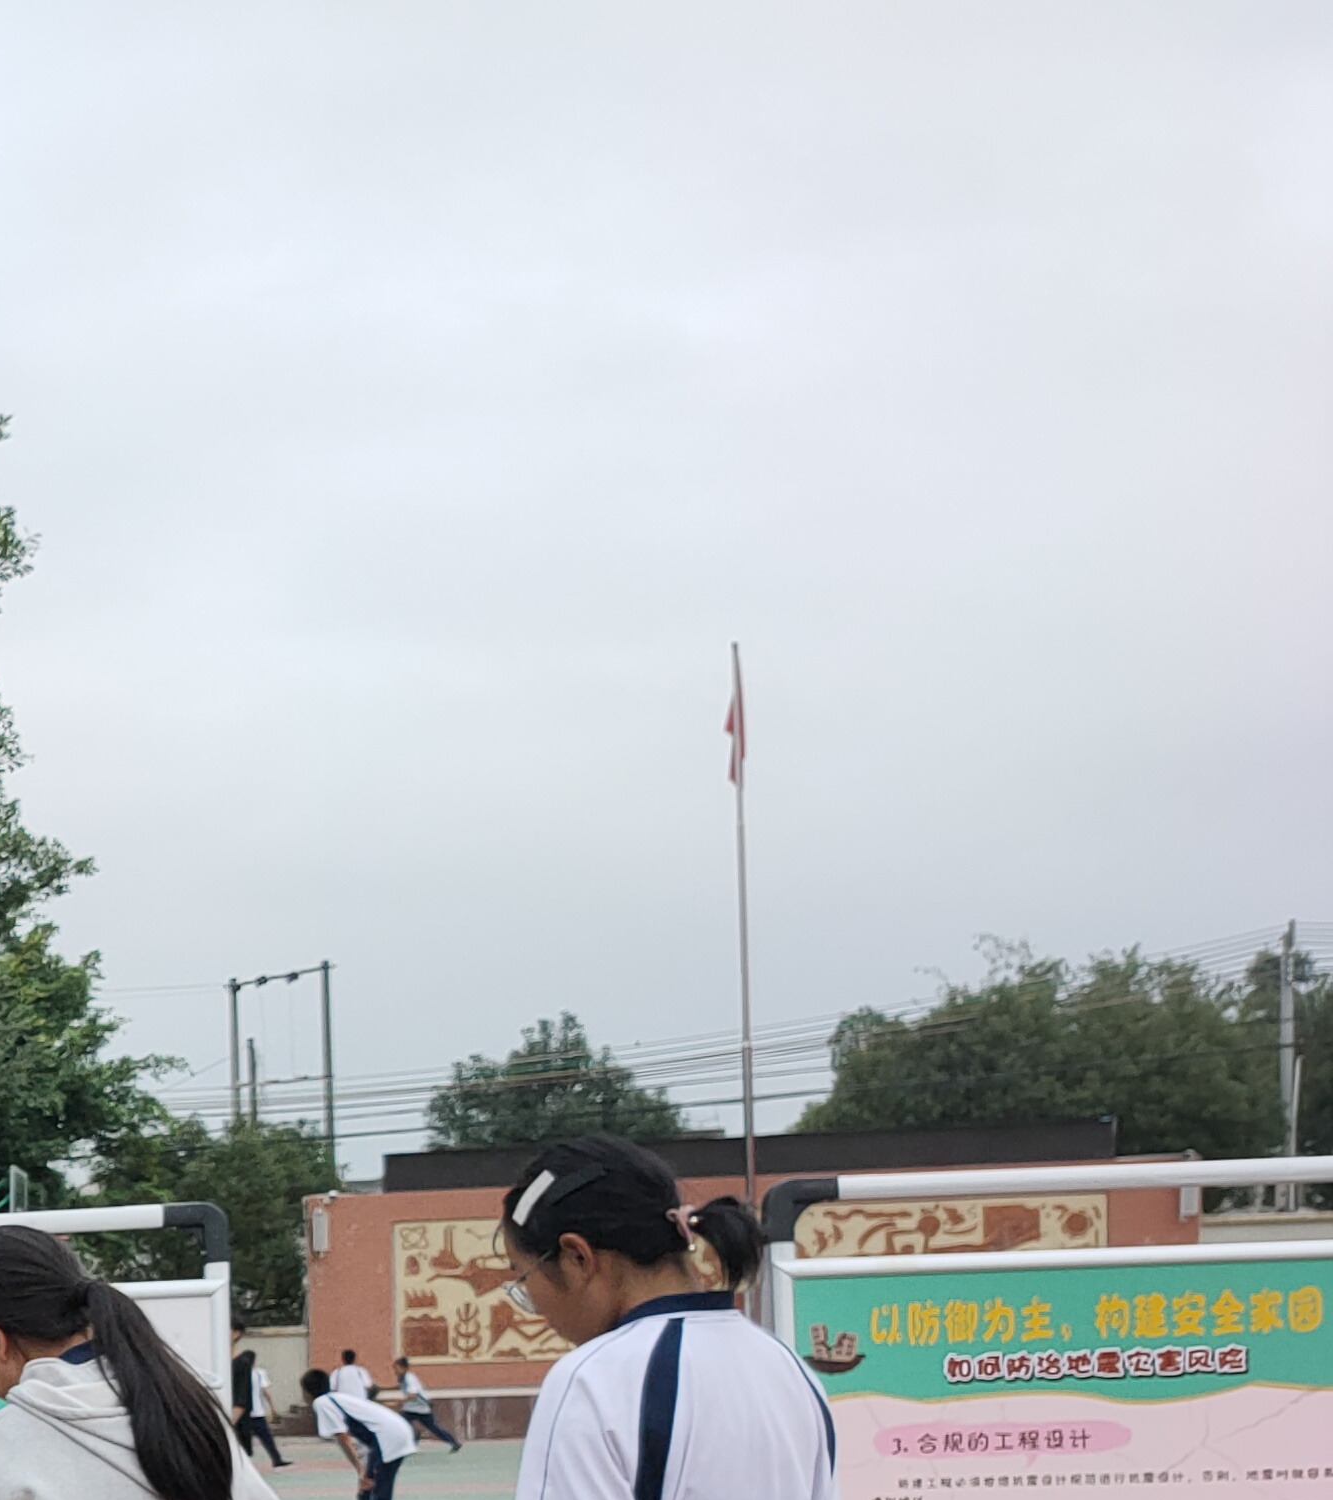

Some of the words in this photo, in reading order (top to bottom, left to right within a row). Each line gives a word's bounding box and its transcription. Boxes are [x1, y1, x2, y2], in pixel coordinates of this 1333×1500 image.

[870, 1286, 1323, 1346] 以防御为主，构建安全家园
[945, 1346, 1249, 1383] 如何防治地震灾害风险
